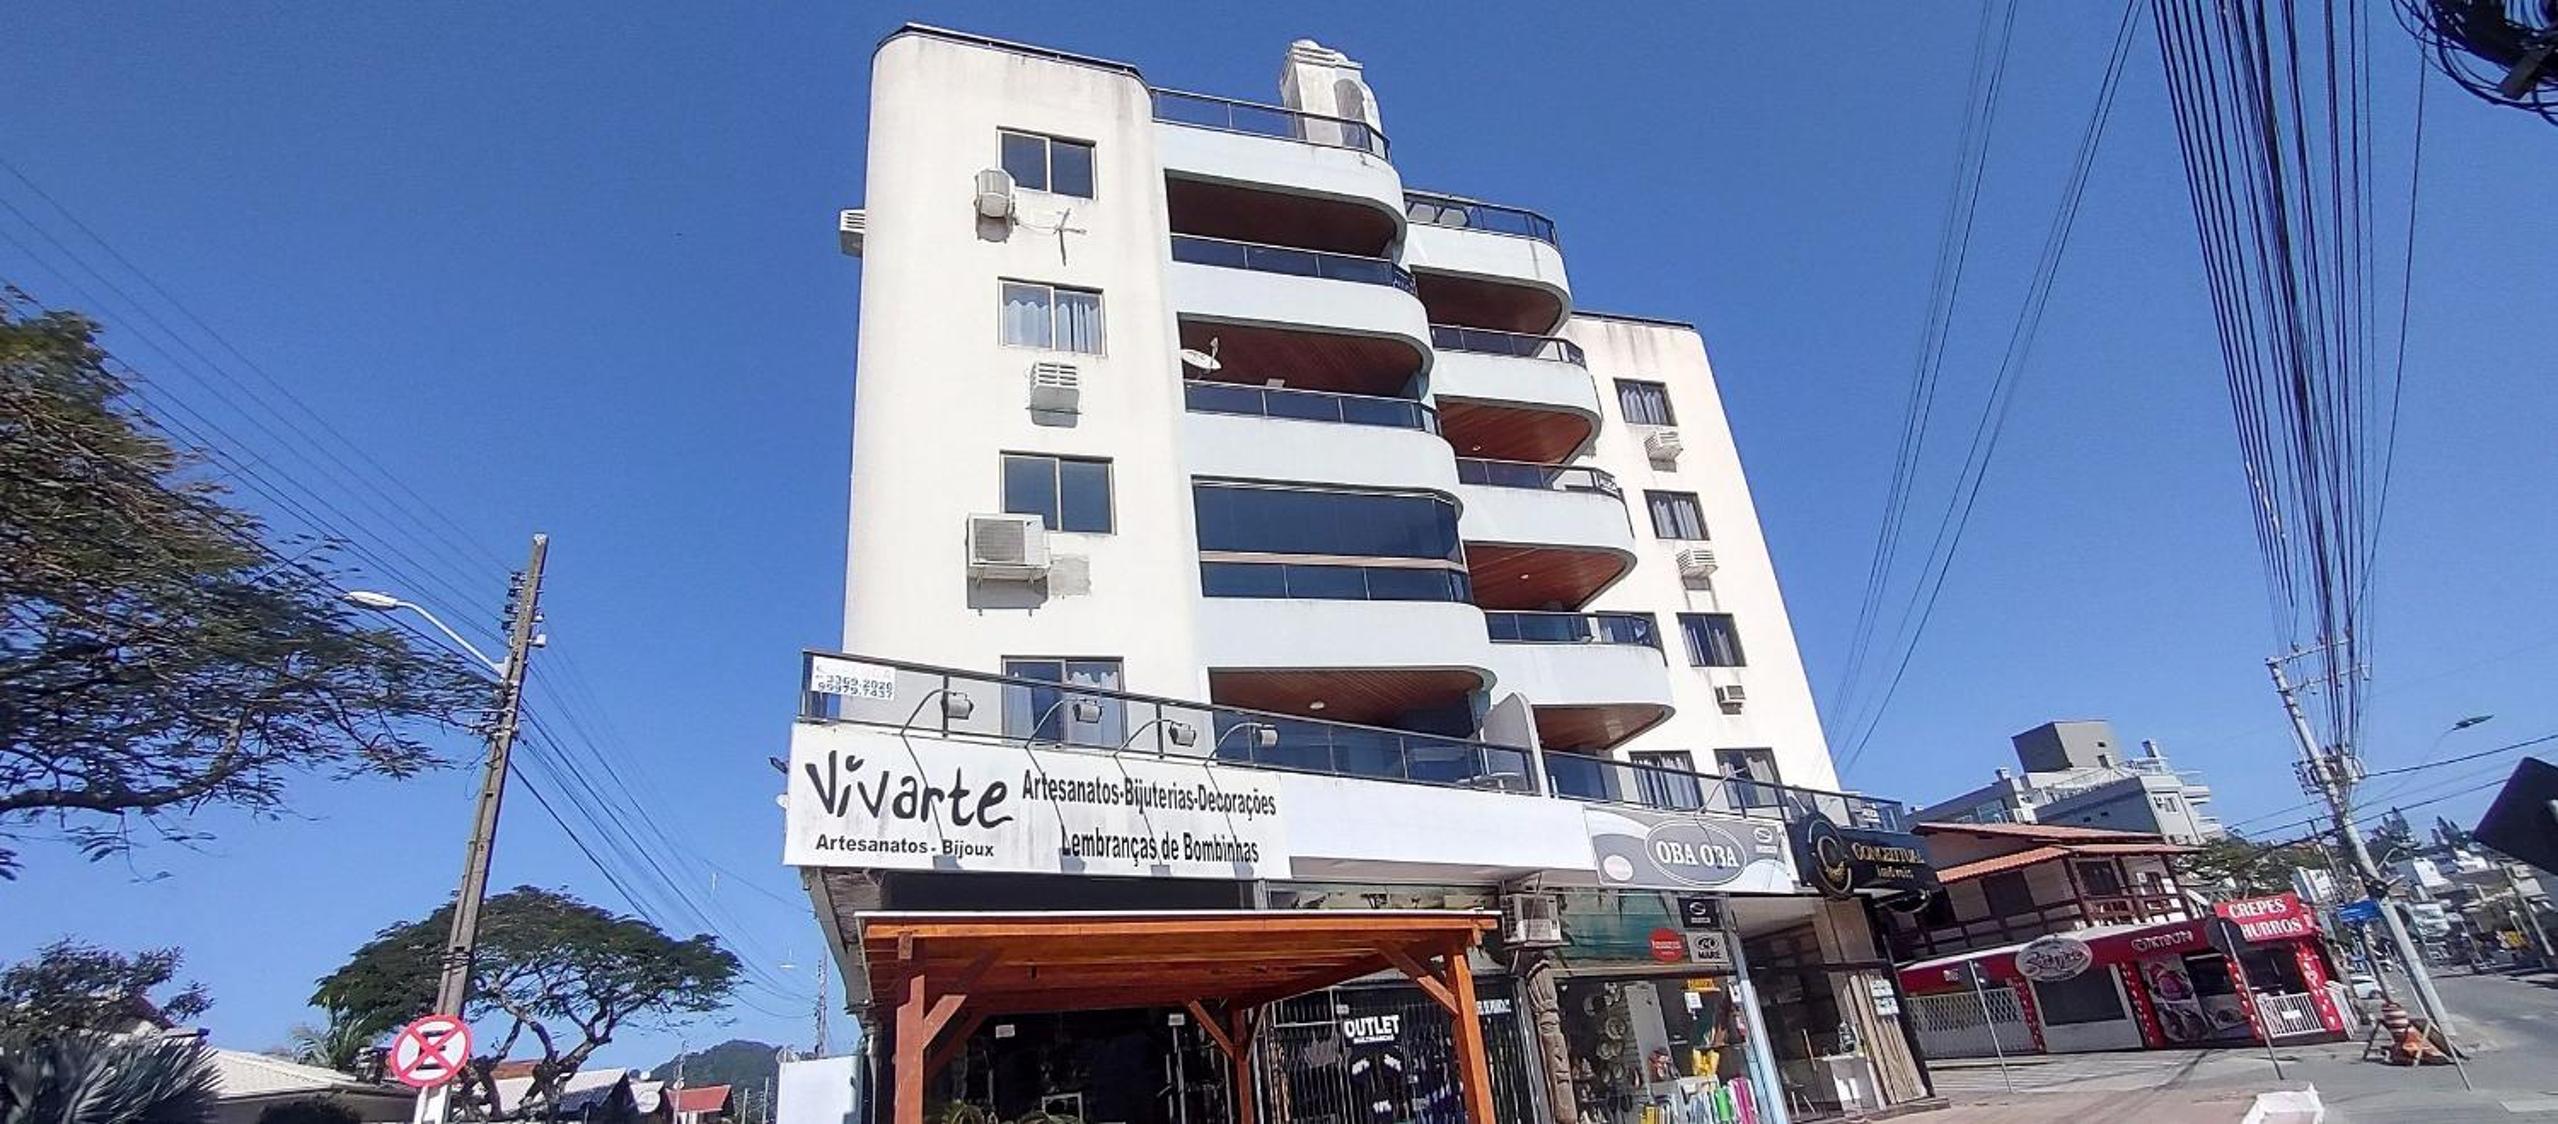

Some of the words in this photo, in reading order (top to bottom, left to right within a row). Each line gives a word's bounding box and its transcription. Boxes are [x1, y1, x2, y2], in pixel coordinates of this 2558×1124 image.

[805, 750, 1014, 829] Vivarte
[816, 834, 928, 853] Artesanatos
[942, 839, 994, 859] Bijoux
[1061, 826, 1157, 867] Lembranças
[1162, 831, 1180, 861] de
[1183, 832, 1260, 864] Bombinhas
[1655, 840, 1699, 866] OBA
[1700, 844, 1740, 868] OBA
[2228, 898, 2287, 919] CREPES
[2239, 917, 2303, 940] HURROS
[1344, 1014, 1400, 1037] OUTLET
